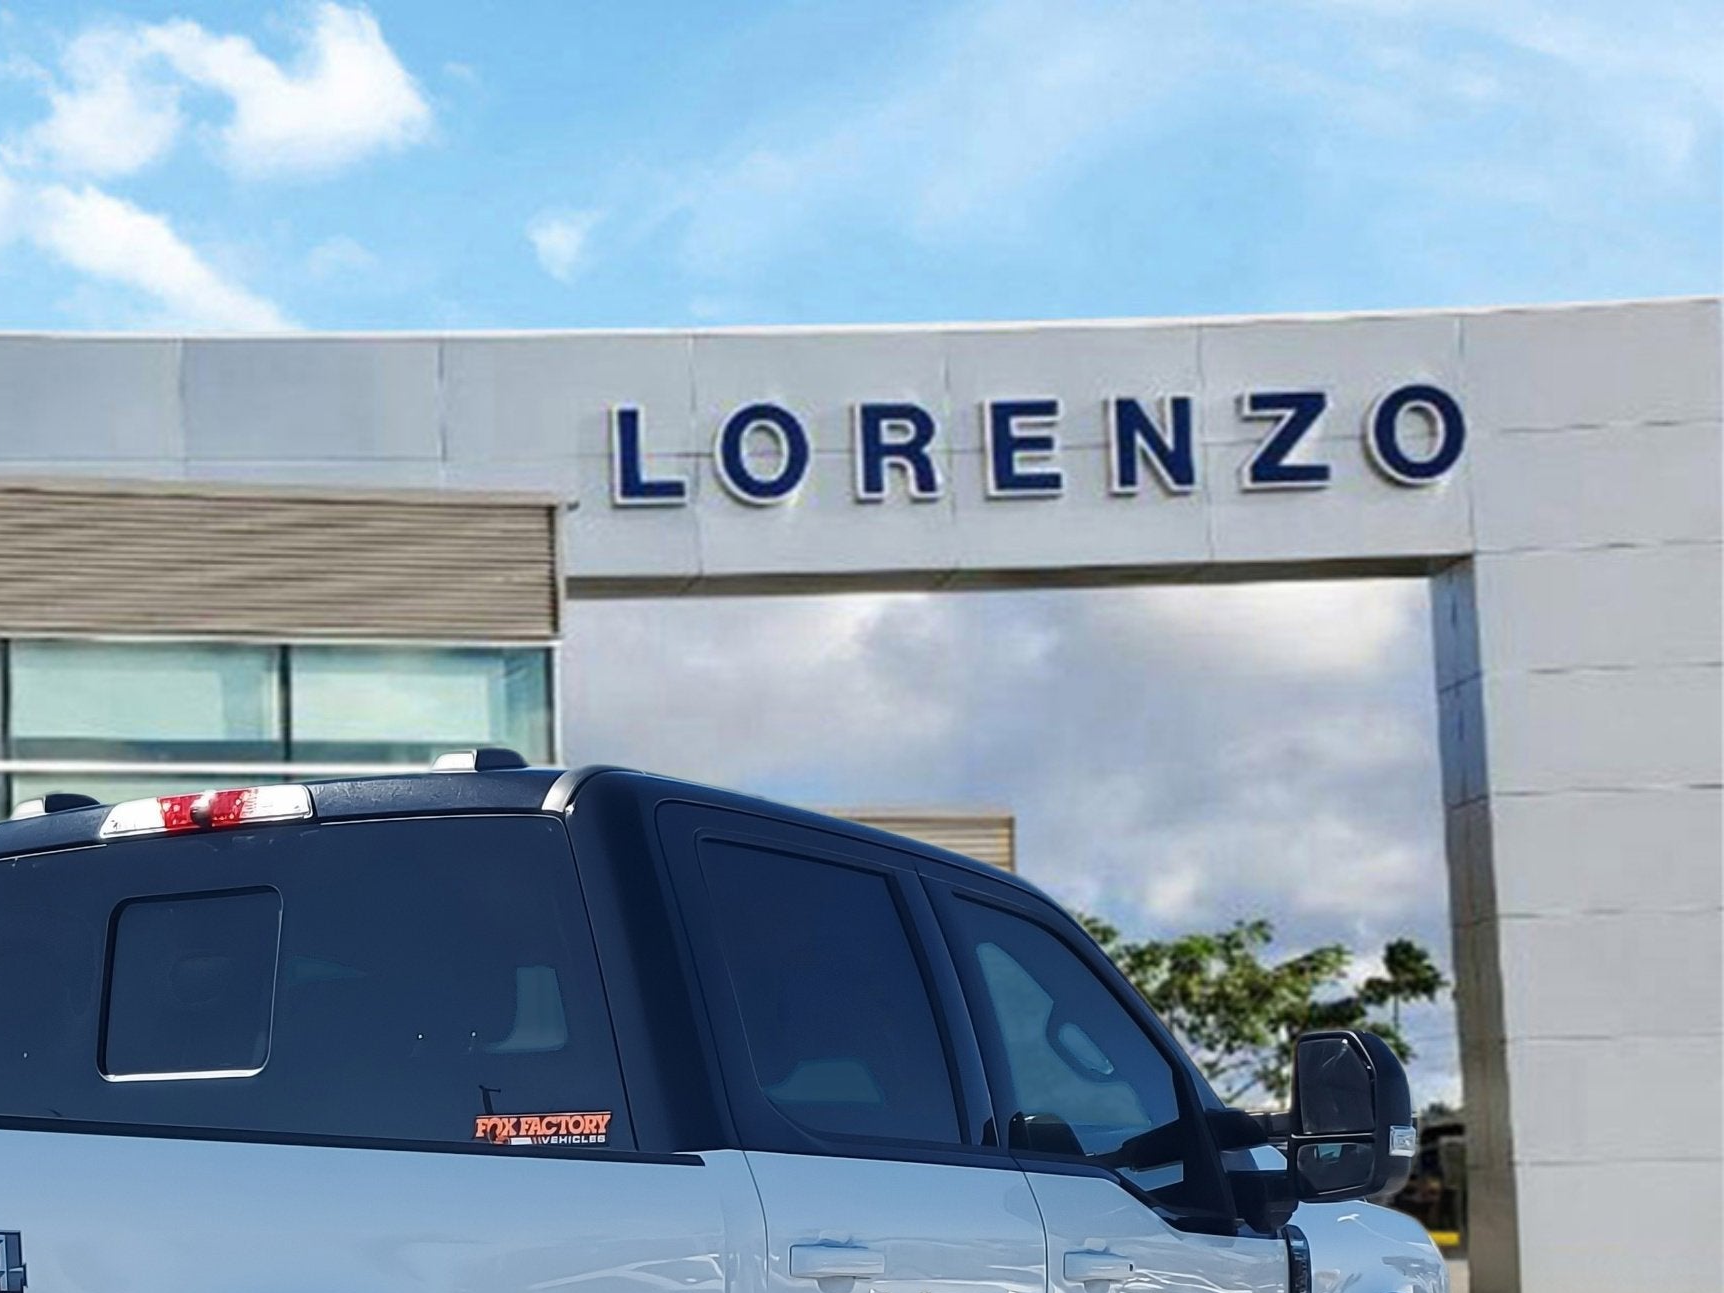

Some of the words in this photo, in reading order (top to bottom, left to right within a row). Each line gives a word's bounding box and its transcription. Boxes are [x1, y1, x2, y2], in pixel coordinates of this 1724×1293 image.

[610, 384, 1467, 506] LORENZO
[476, 1117, 517, 1143] FOX
[521, 1115, 610, 1135] FACTORY
[541, 1135, 606, 1144] VEHICLES
